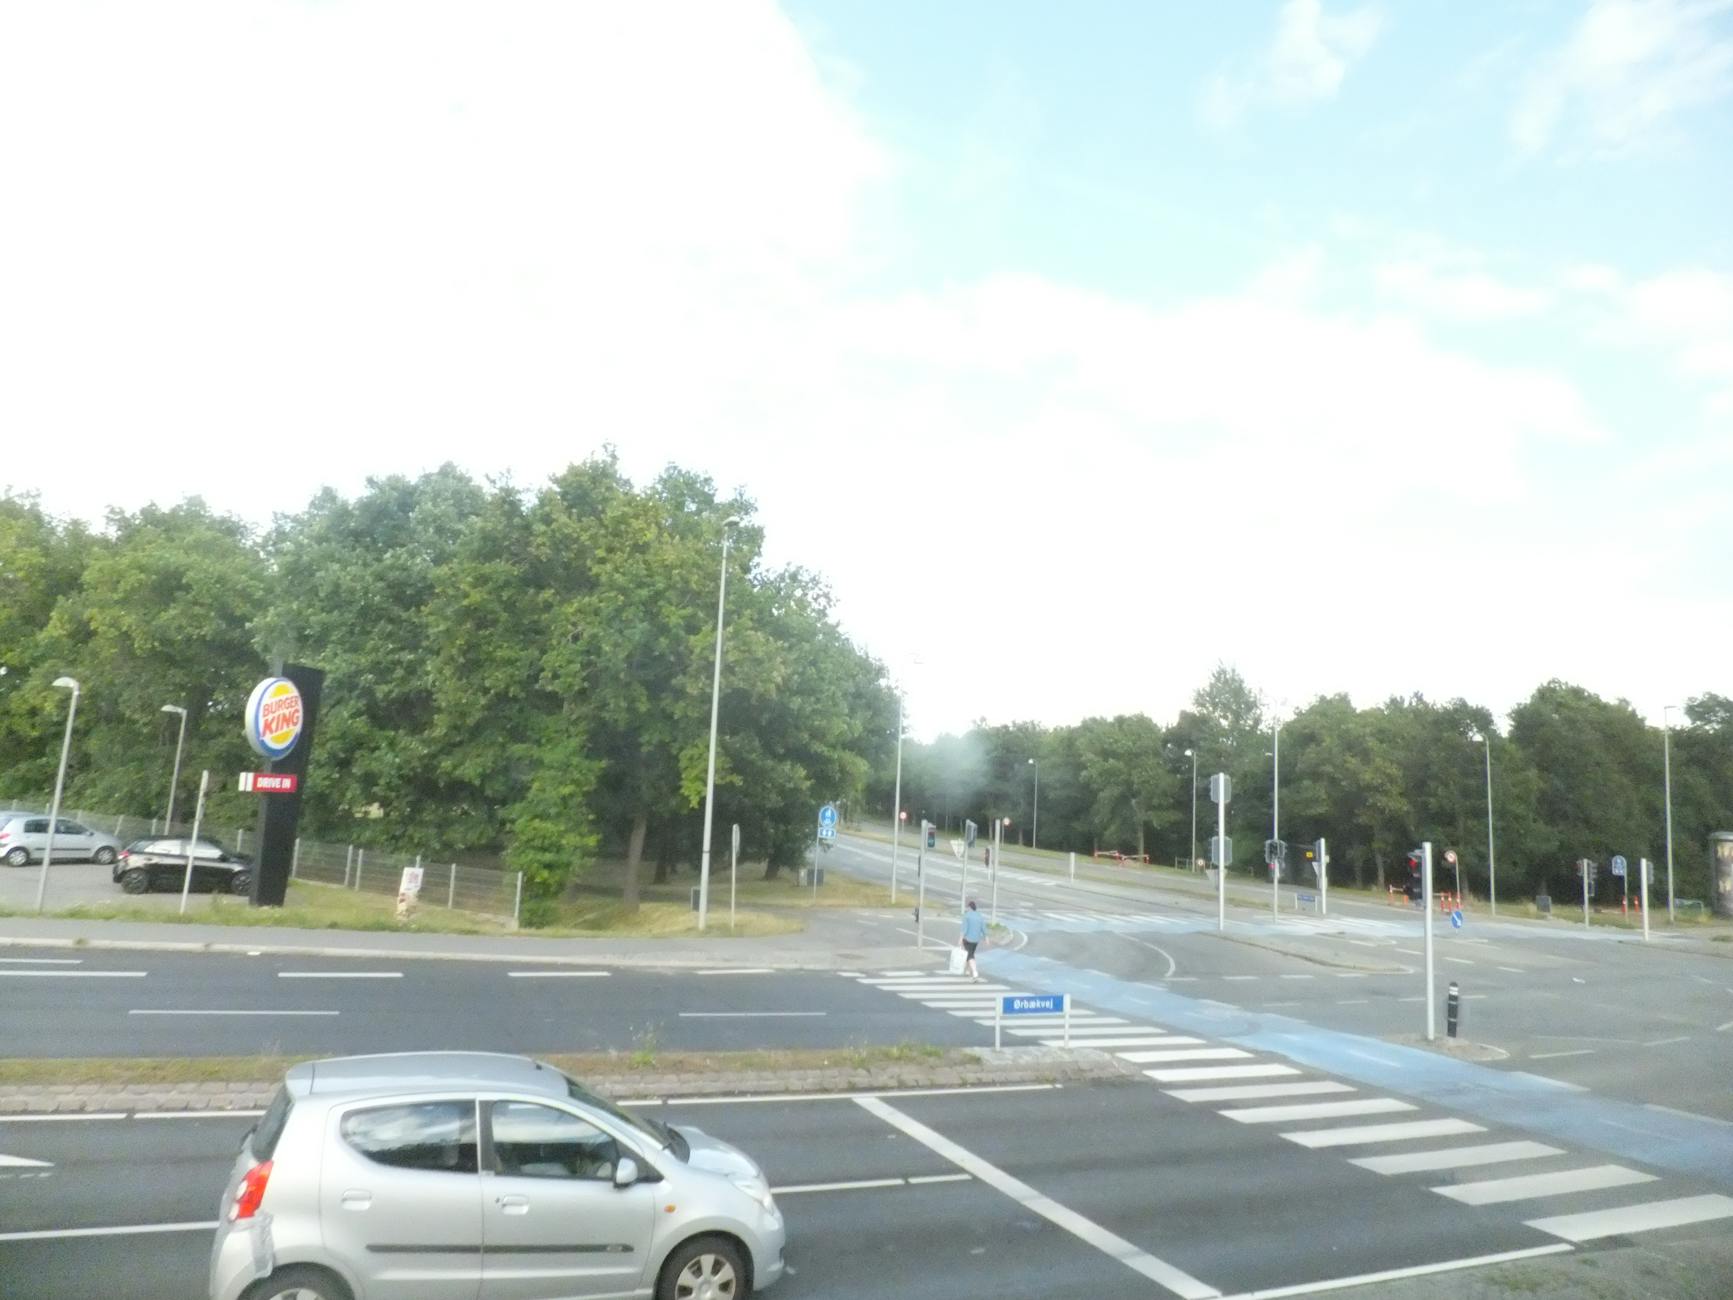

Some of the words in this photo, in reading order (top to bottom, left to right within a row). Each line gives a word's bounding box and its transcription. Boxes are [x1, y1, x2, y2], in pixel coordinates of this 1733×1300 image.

[263, 696, 299, 717] BURGER
[262, 709, 299, 737] KING
[257, 777, 281, 788] DRIVE
[282, 778, 291, 788] IN
[1014, 998, 1053, 1009] Ørbækvej
